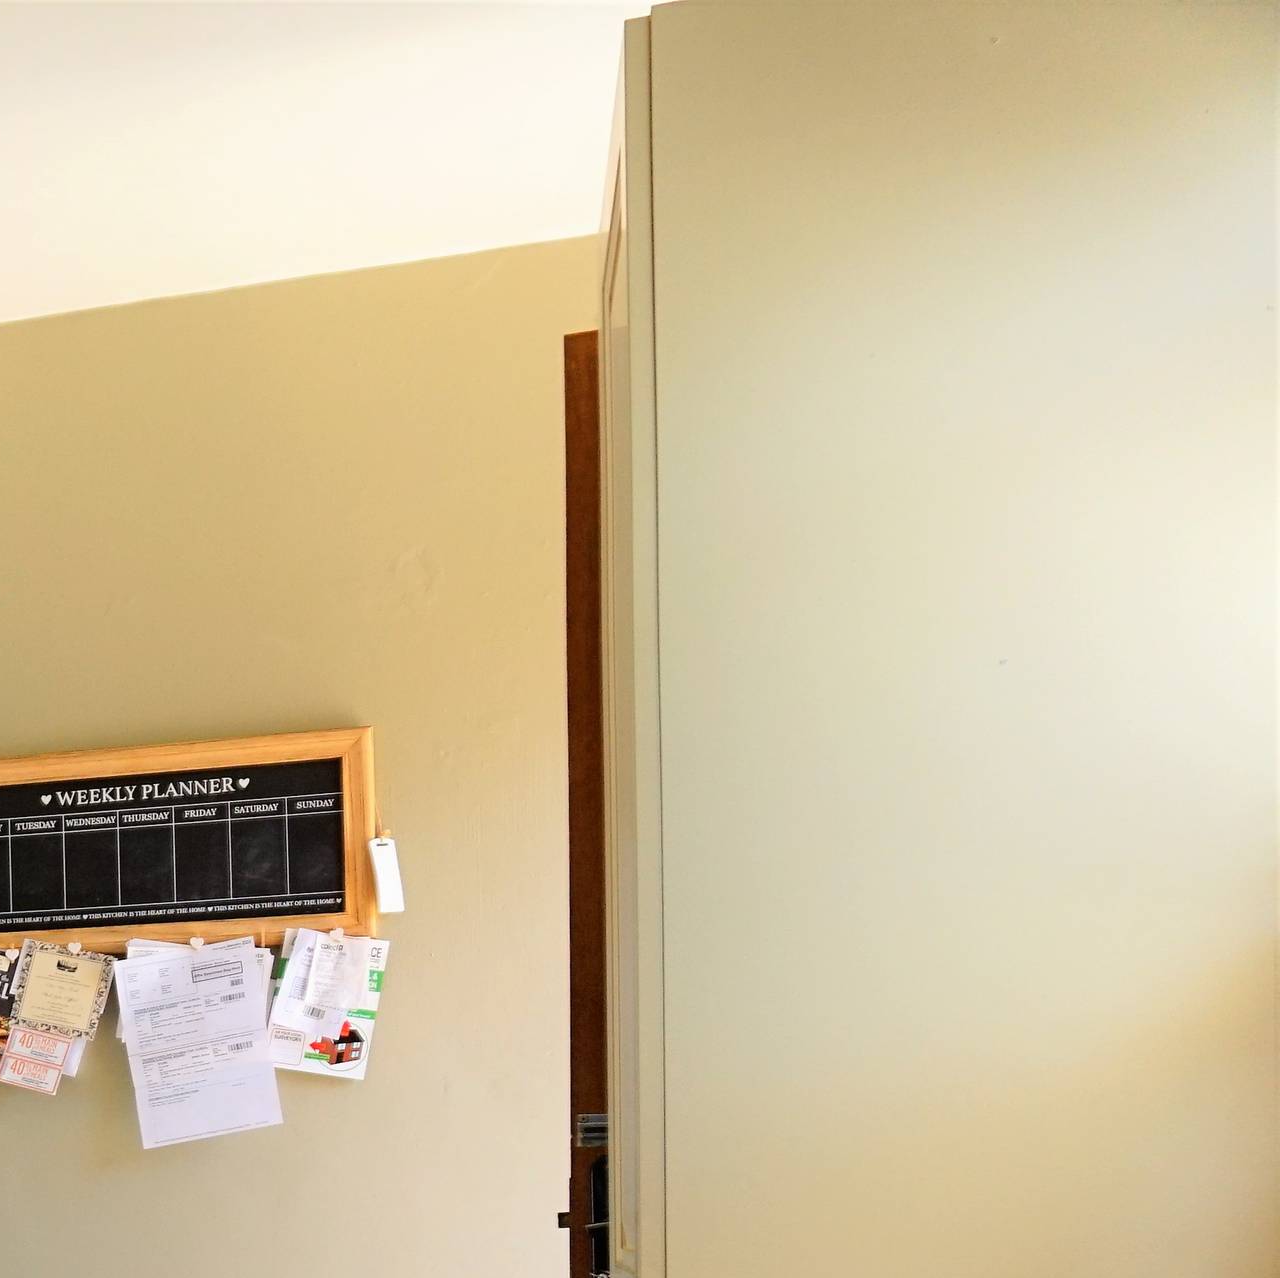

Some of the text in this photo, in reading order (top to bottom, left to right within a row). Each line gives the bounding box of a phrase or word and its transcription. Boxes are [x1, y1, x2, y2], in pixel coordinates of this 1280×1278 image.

[56, 777, 236, 807] WEEKLY PLANNER
[15, 820, 57, 831] TUESDAY
[65, 816, 116, 827] WEDNESDAY
[122, 812, 170, 823] THURSDAY
[184, 807, 217, 818] FRIDAY
[234, 803, 279, 814] SATURDAY
[296, 799, 335, 809] SUNDAY
[19, 1033, 34, 1048] 40
[10, 1060, 25, 1075] 40
